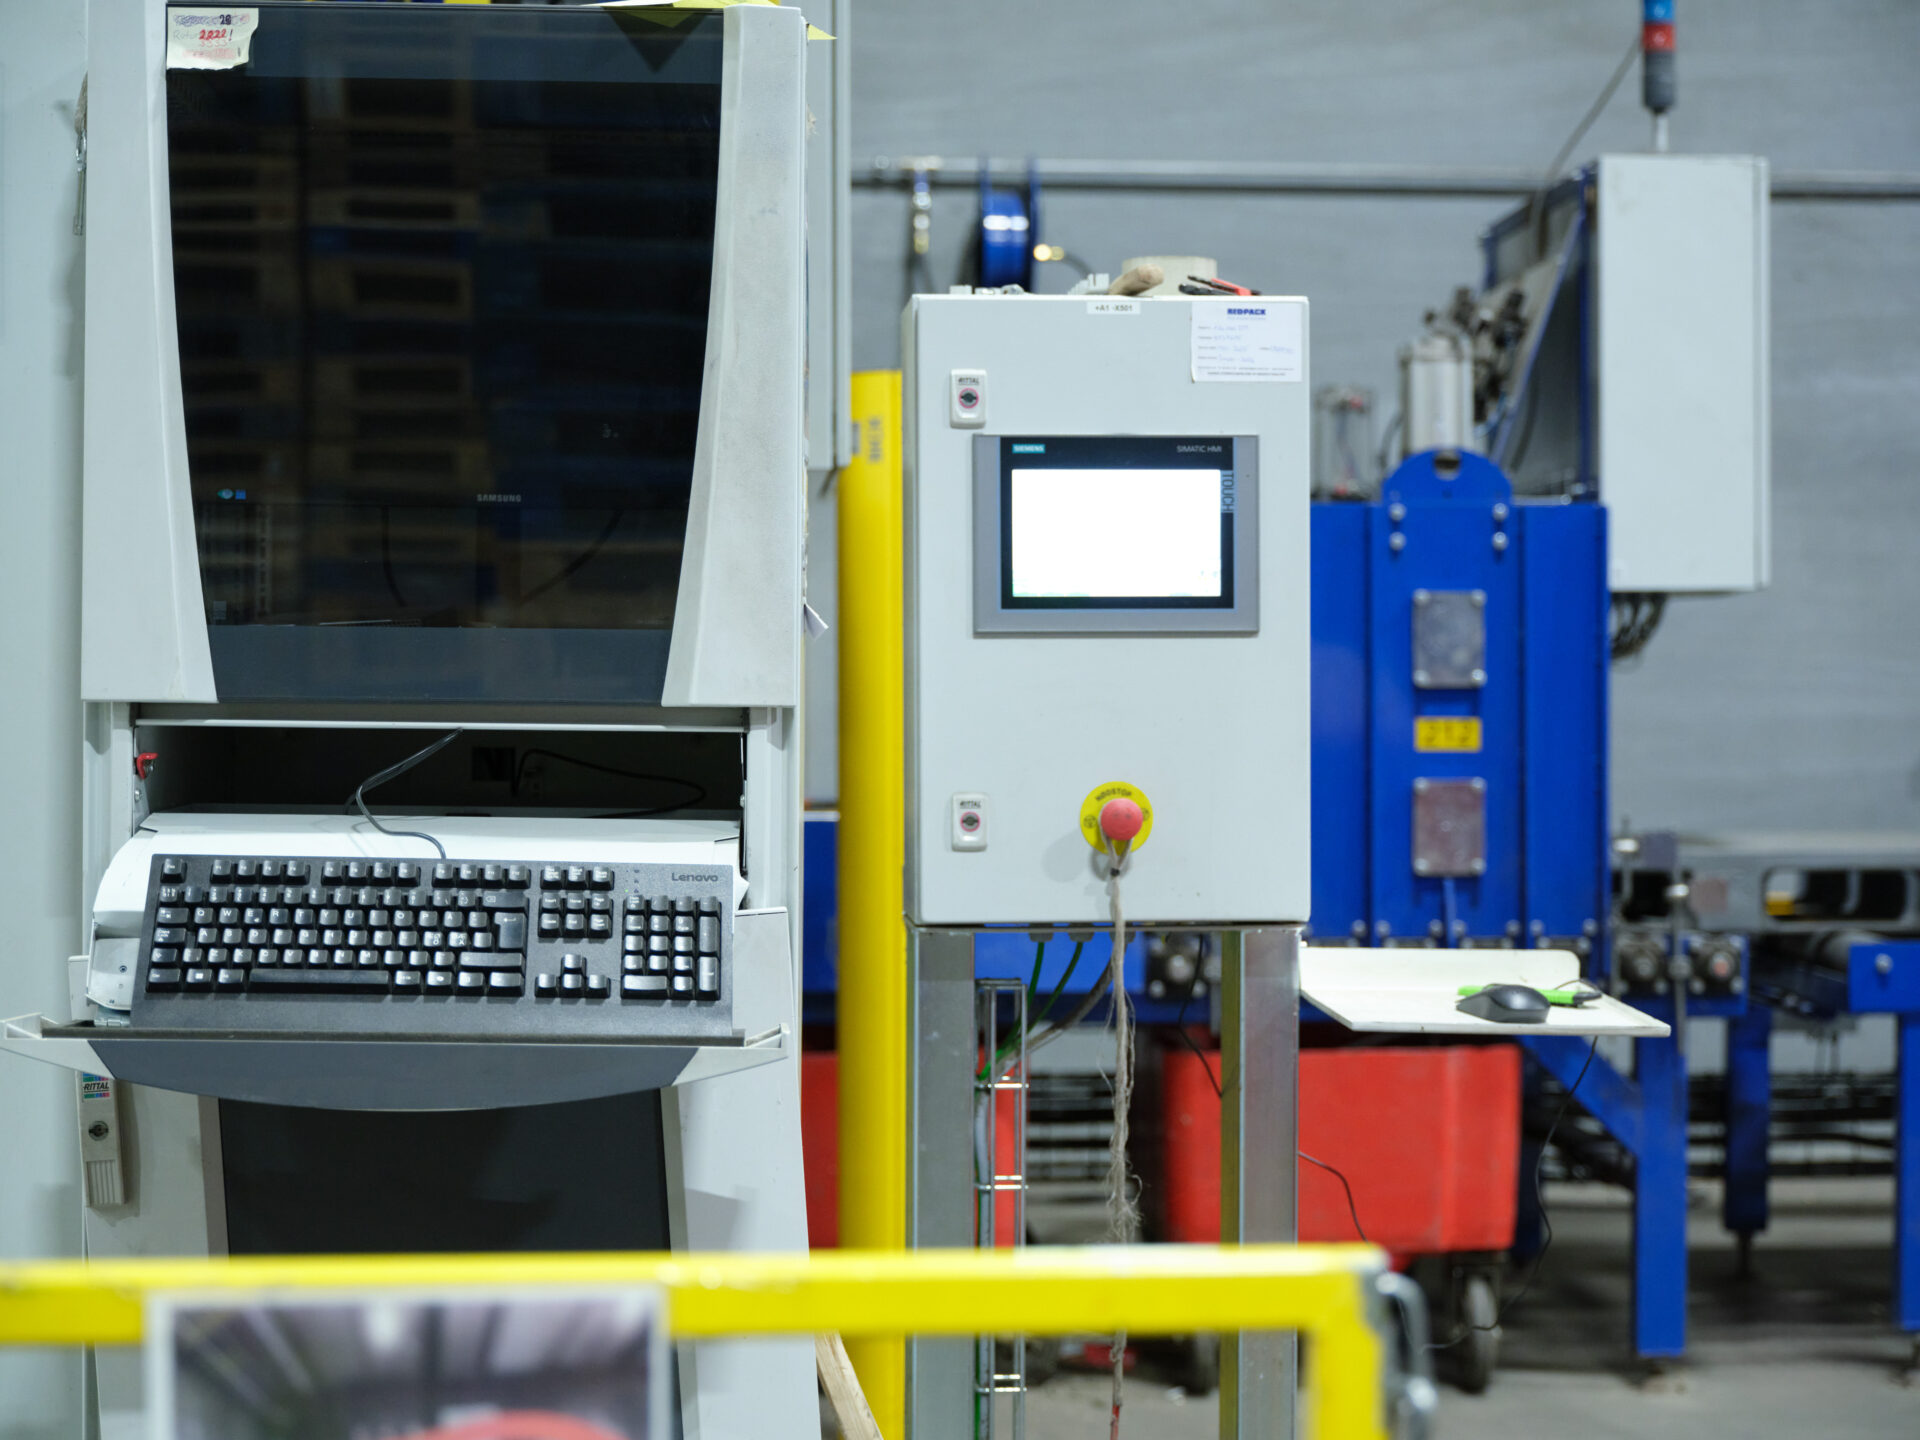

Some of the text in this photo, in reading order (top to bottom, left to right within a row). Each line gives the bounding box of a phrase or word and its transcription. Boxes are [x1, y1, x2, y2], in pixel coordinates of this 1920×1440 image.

[1176, 445, 1206, 453] SIMATIC
[1222, 472, 1234, 513] TOUCH
[477, 494, 522, 503] SAMSUNG
[671, 872, 719, 882] Lenovo
[83, 1082, 110, 1091] RITTAL
